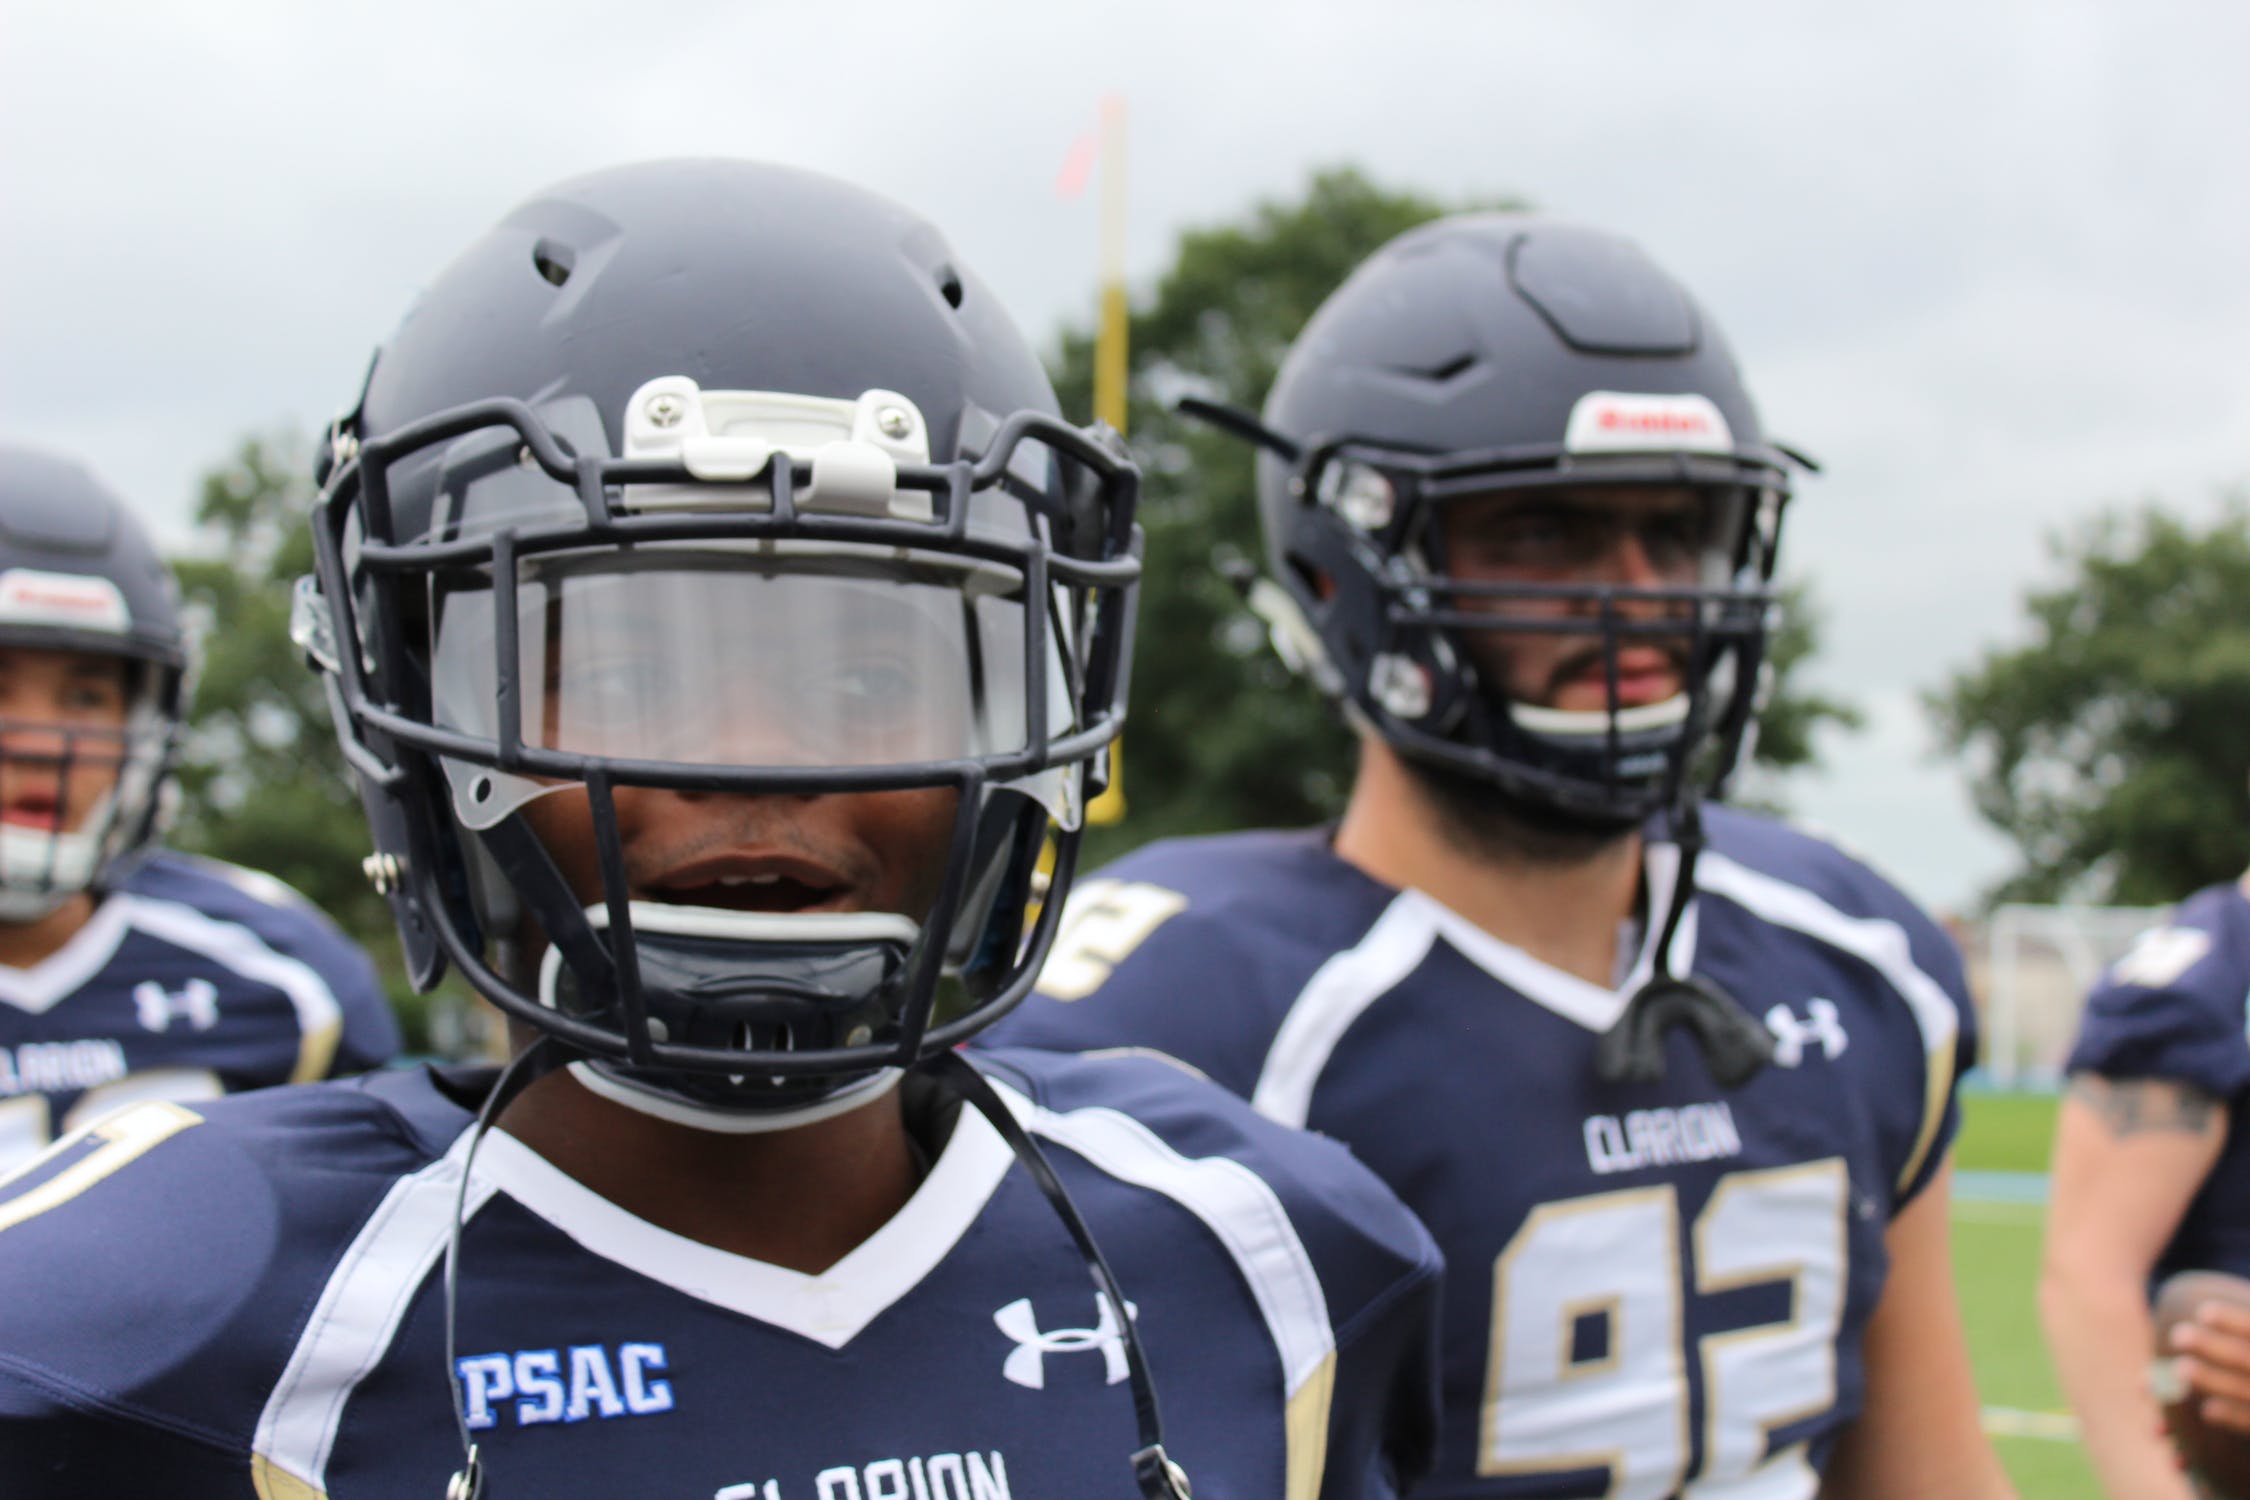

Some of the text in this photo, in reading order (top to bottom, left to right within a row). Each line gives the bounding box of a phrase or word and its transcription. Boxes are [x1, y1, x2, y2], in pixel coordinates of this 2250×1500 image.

[1583, 1100, 1742, 1174] CLARION
[1476, 1156, 1850, 1500] 92
[456, 1341, 675, 1430] PSAC
